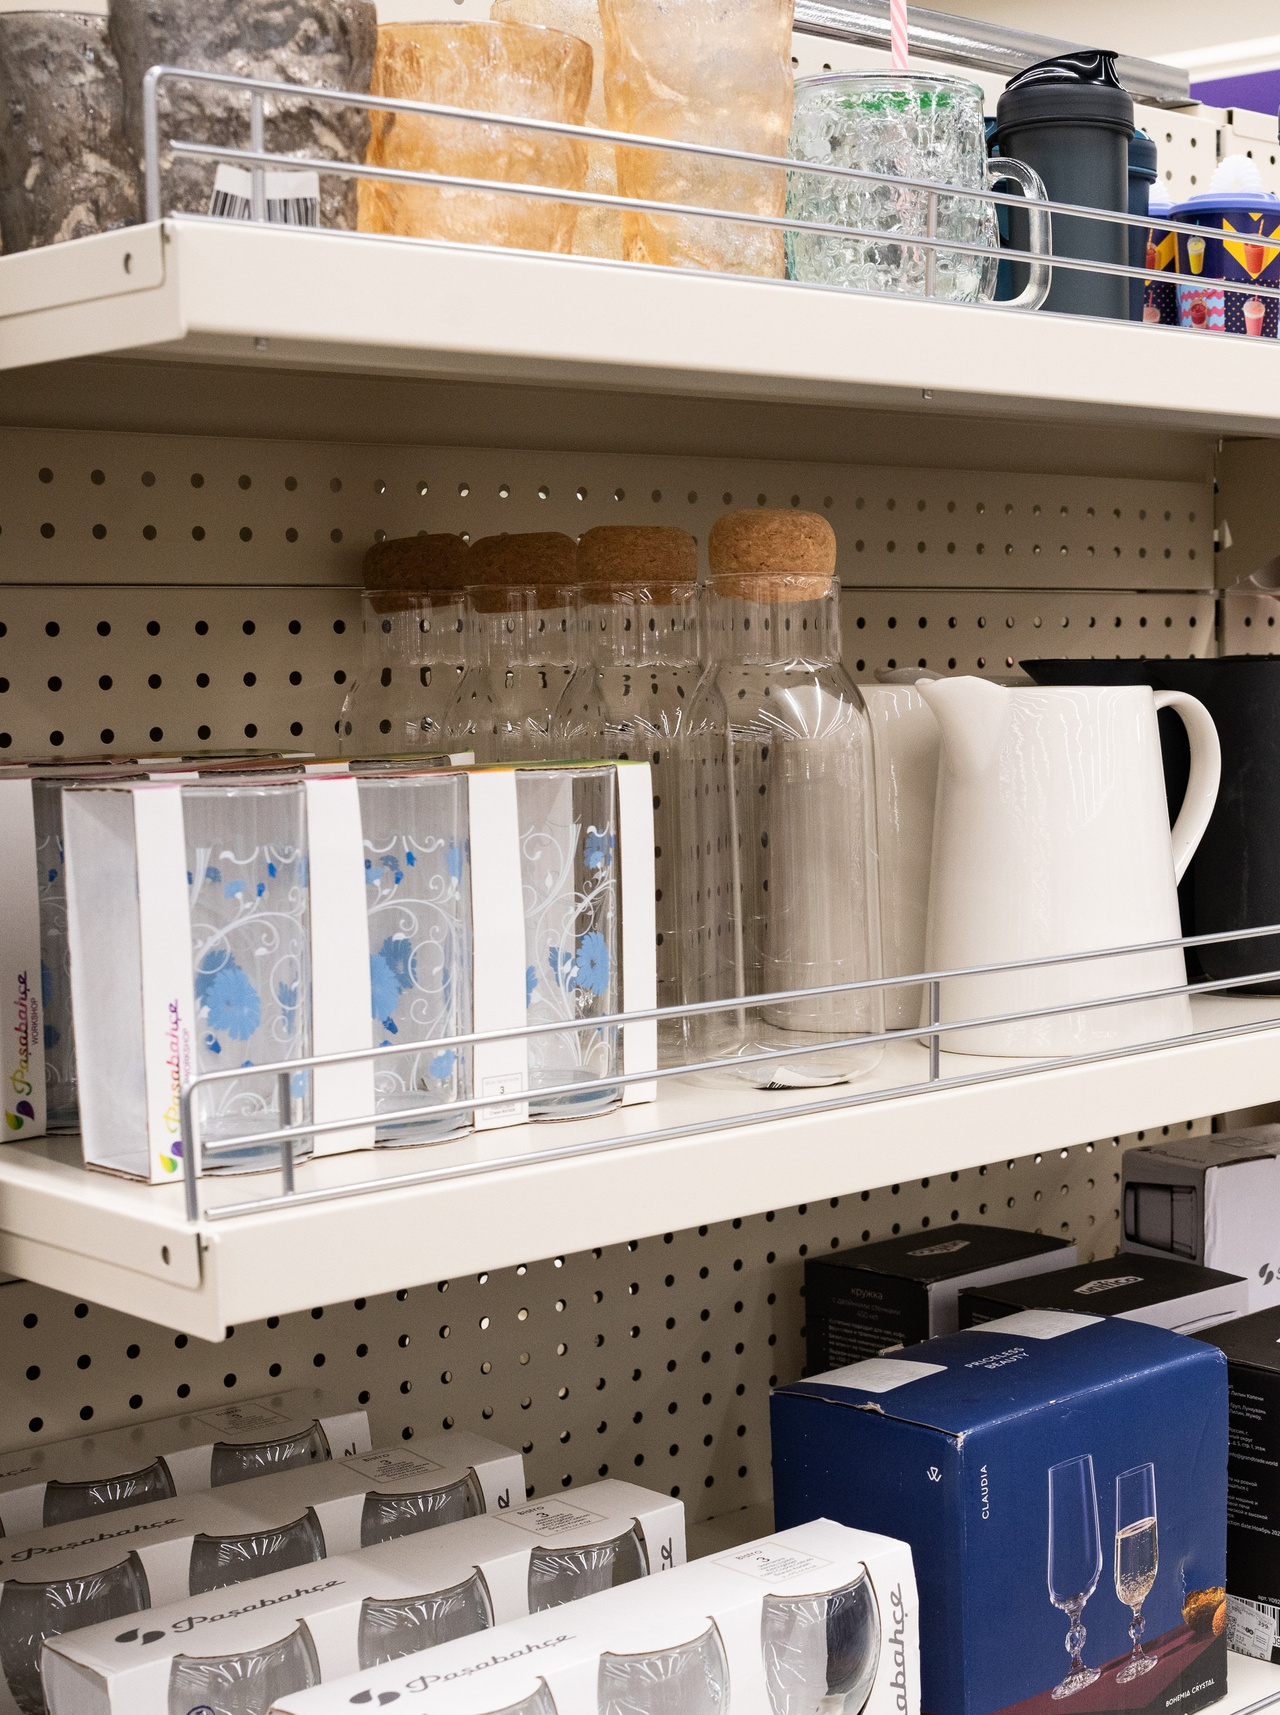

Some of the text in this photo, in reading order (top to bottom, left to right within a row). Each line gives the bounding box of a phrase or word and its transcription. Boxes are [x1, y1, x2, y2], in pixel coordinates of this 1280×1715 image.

[31, 997, 41, 1046] WORKSHOP
[500, 1085, 505, 1095] 3
[851, 1287, 883, 1301] кружка
[1079, 1276, 1141, 1294] unifico
[964, 1347, 1025, 1369] PRICELESS
[984, 1352, 1029, 1370] BEAUTY
[980, 1464, 990, 1520] CLAUDIA
[517, 1505, 545, 1516] Bistro
[11, 1517, 184, 1561] Paşabahçe
[735, 1550, 763, 1560] Bistro
[171, 1579, 346, 1633] Paşabahçe
[889, 1582, 908, 1715] abahçe
[405, 1634, 577, 1693] Paşabahçe
[1165, 1678, 1215, 1707] BOHEMIA CRYSTAL
